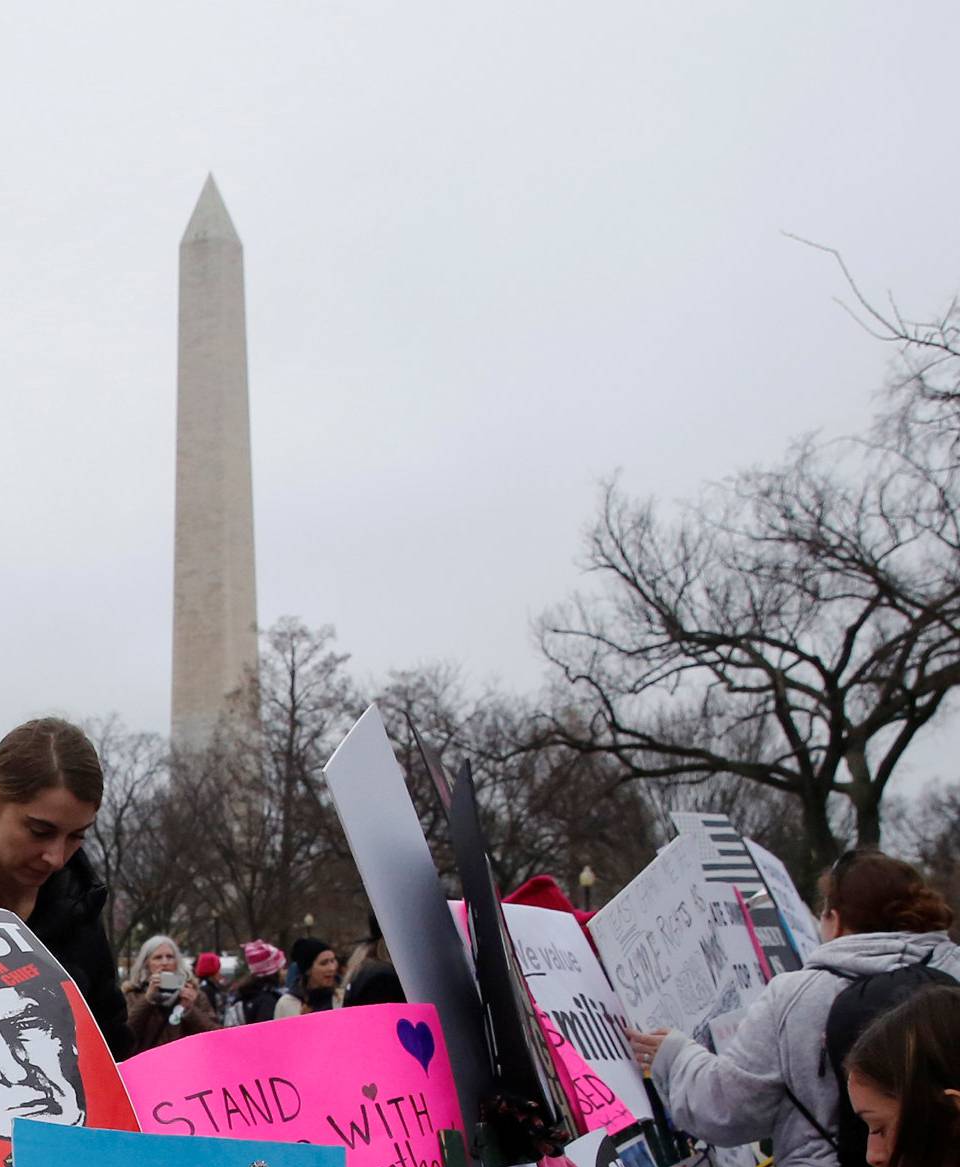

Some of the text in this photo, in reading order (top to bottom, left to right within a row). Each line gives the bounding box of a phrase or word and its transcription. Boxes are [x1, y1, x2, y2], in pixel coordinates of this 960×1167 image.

[0, 963, 41, 987] CHIEF
[152, 1077, 302, 1137] STAND
[325, 1091, 435, 1151] WITH
